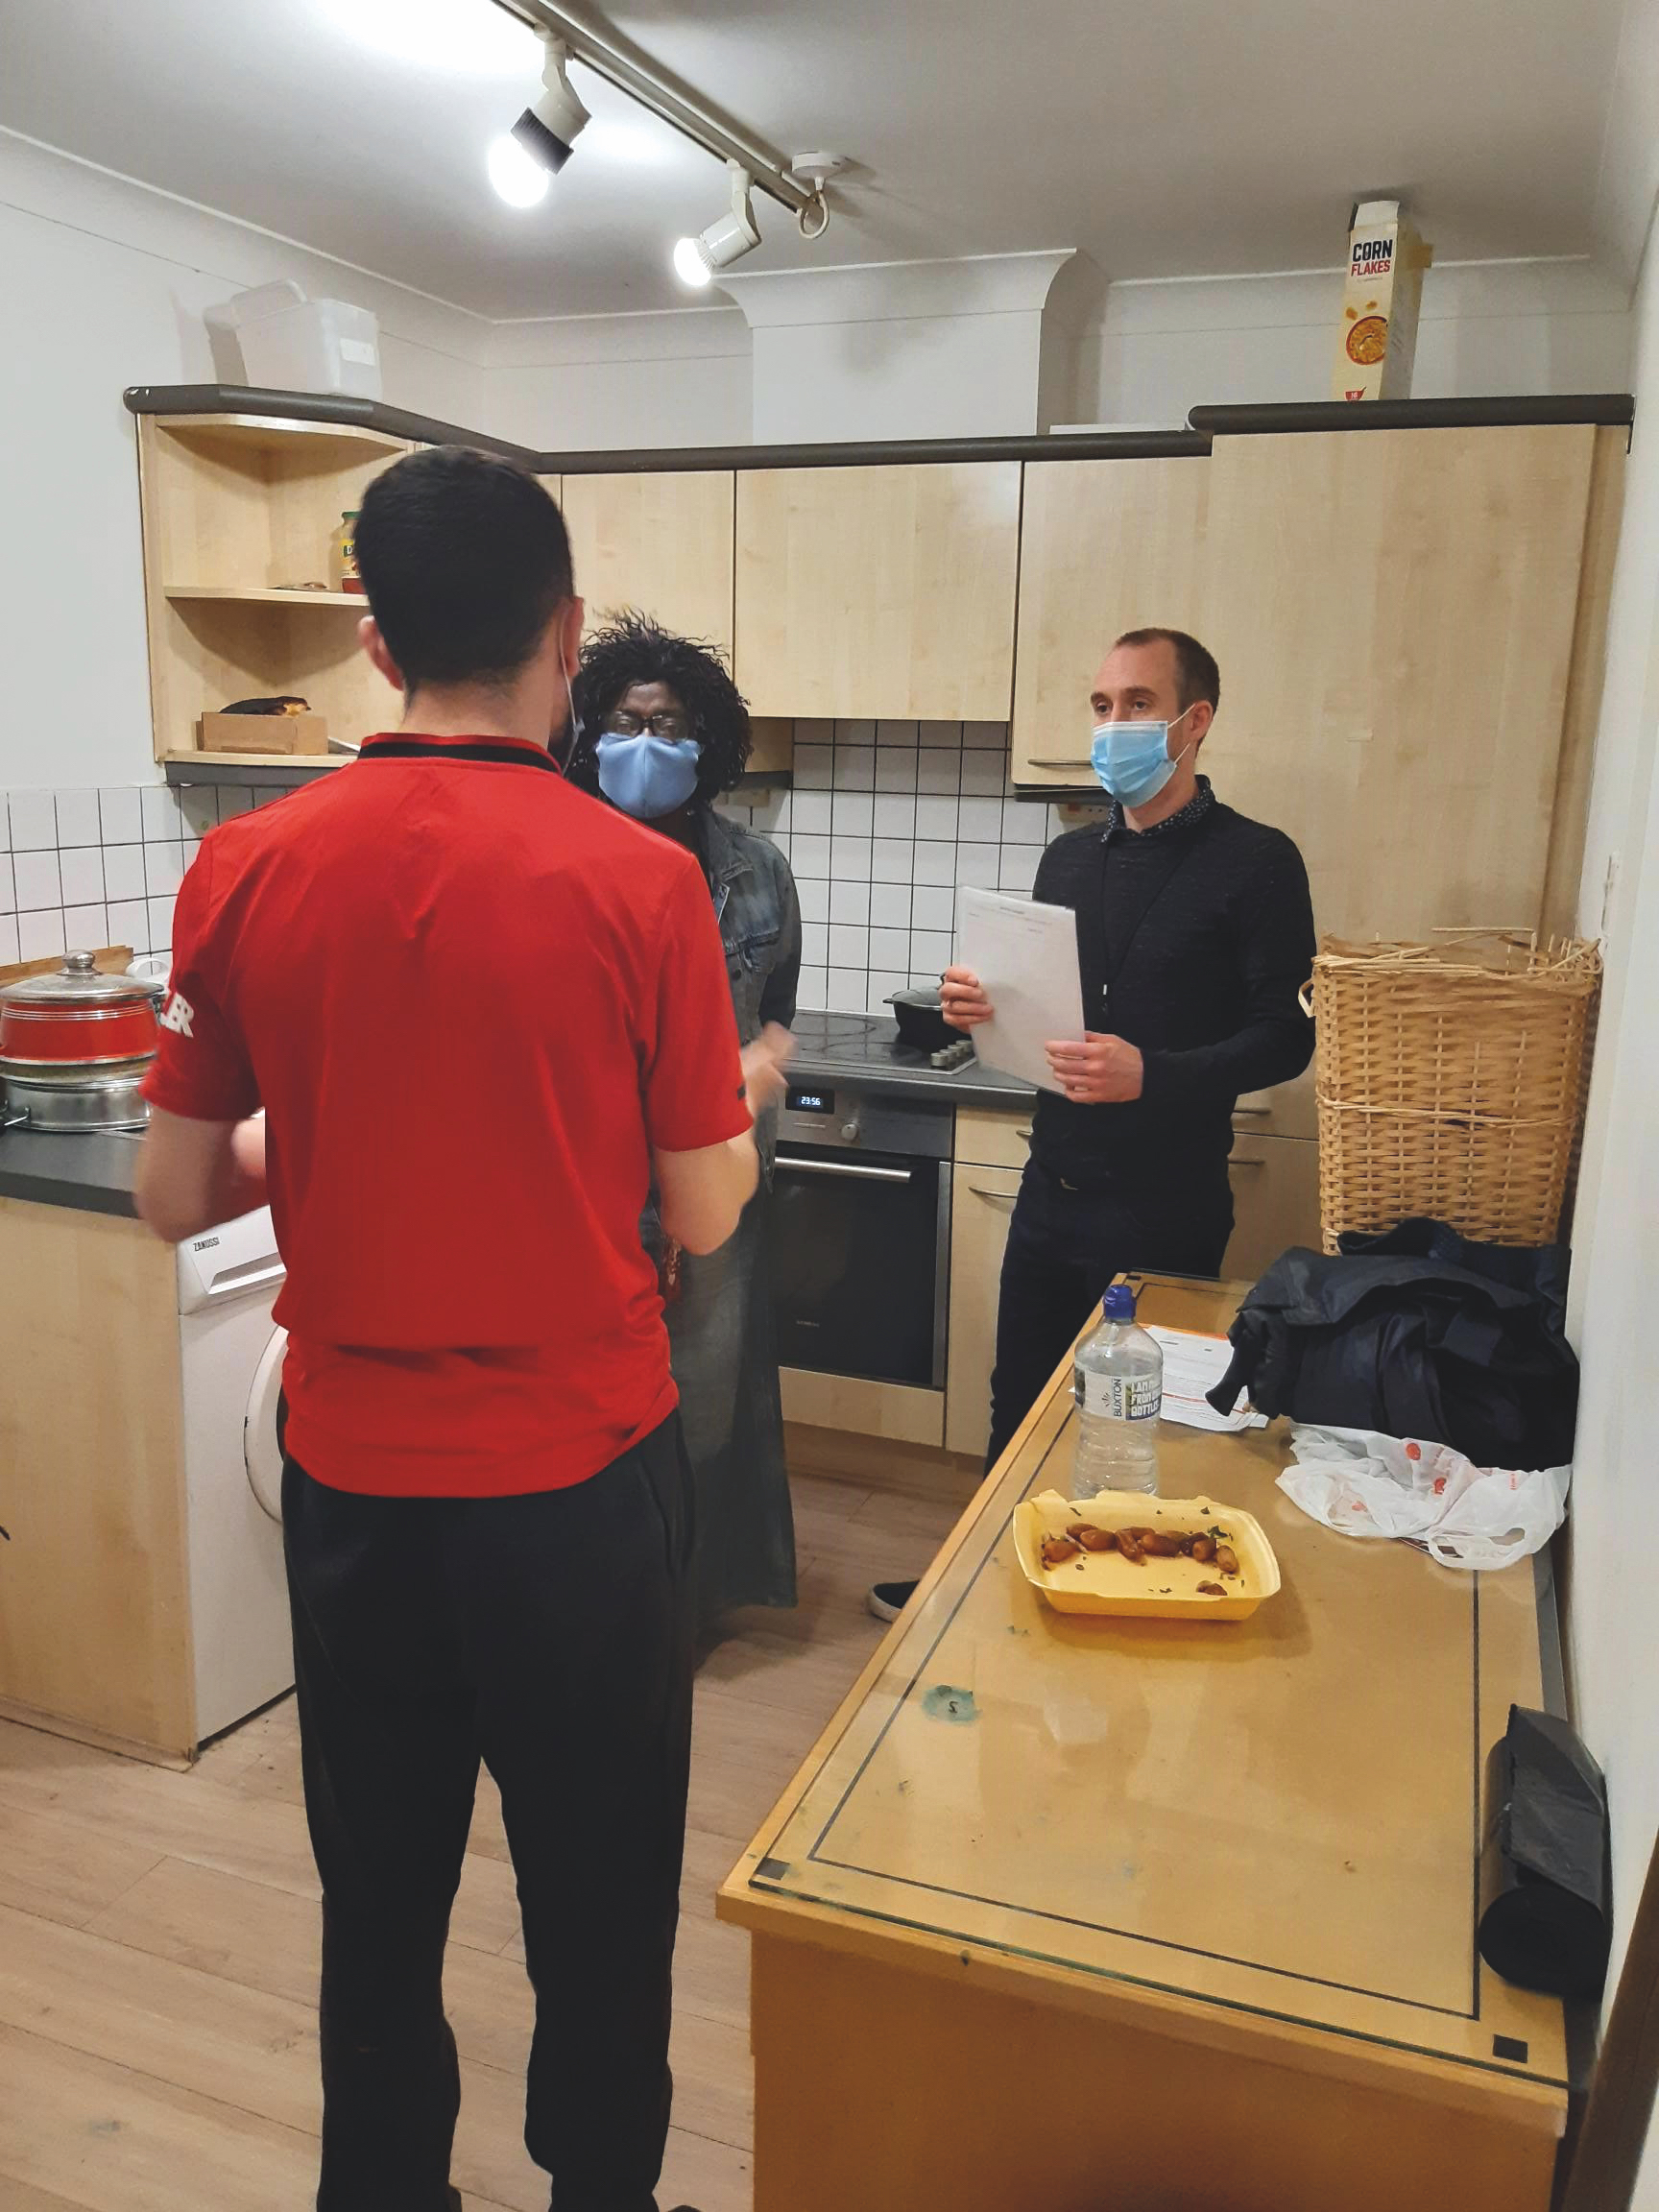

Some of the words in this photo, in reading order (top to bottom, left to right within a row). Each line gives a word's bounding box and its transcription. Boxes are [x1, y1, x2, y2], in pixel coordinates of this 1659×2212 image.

[1352, 239, 1393, 262] CORN
[1351, 259, 1391, 277] FLAKES
[801, 1096, 821, 1106] 23:56
[193, 1237, 220, 1252] ZANUSSI
[1113, 1378, 1122, 1417] BUXTON
[1131, 1392, 1152, 1406] FROM
